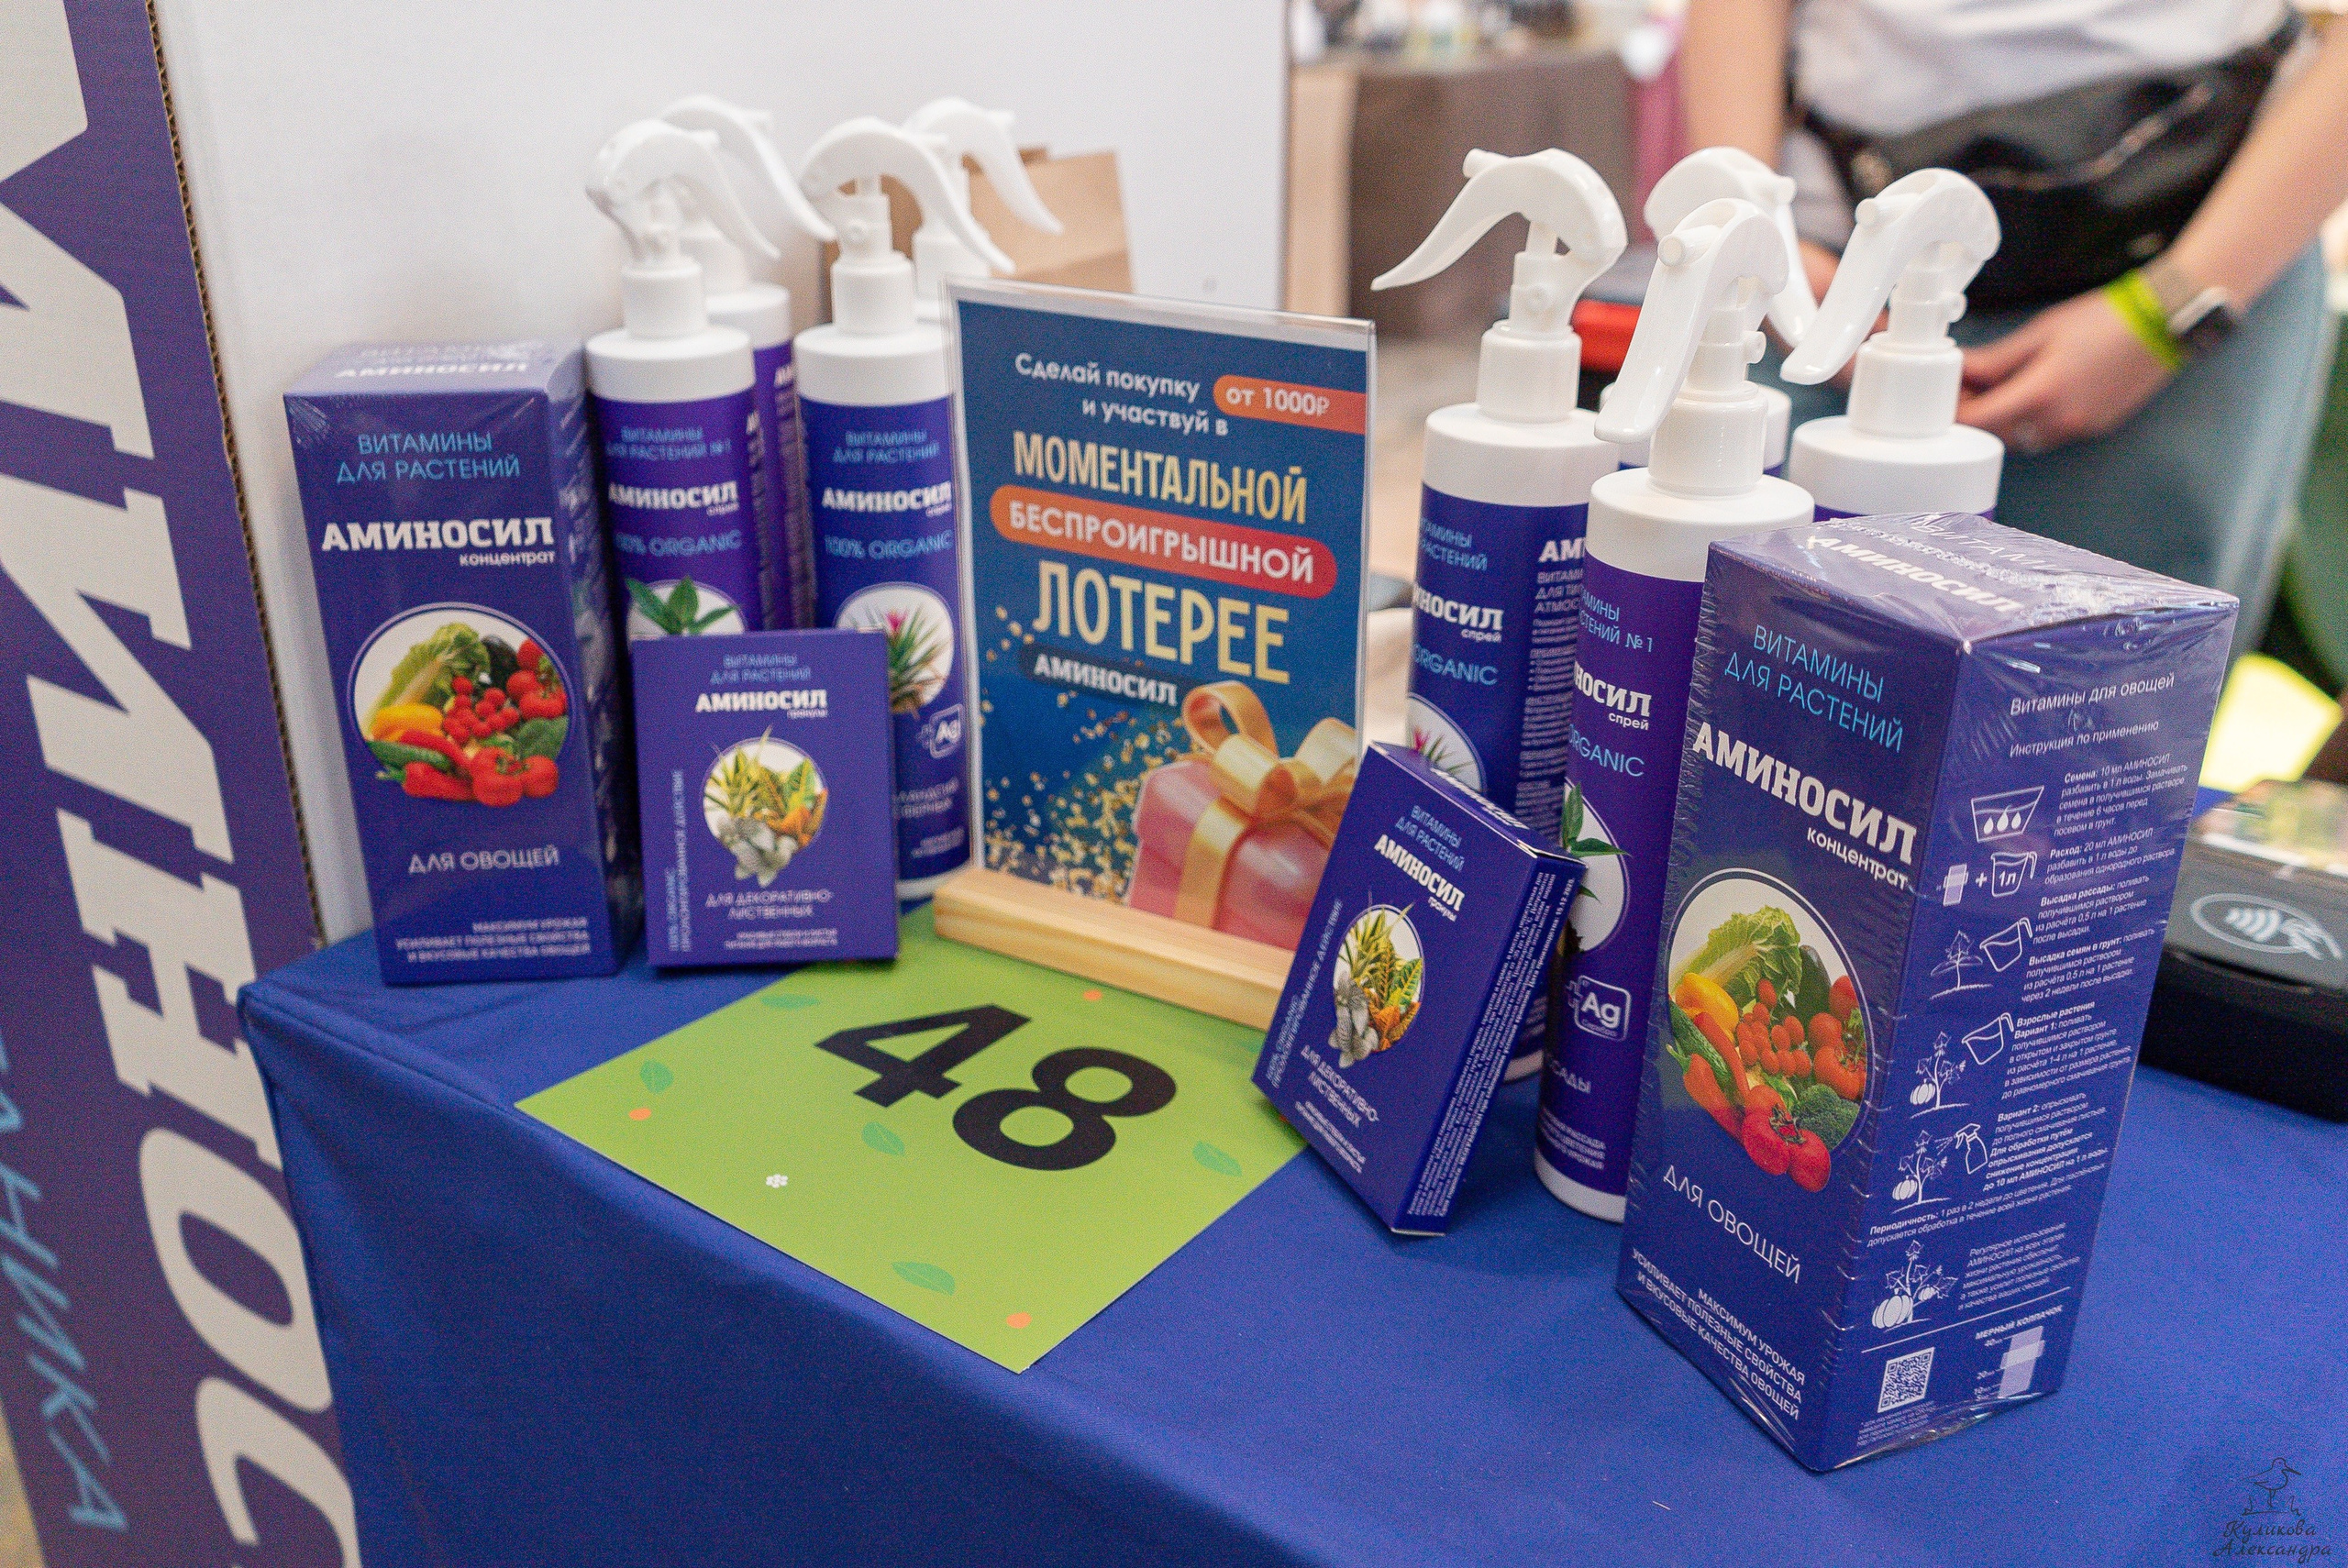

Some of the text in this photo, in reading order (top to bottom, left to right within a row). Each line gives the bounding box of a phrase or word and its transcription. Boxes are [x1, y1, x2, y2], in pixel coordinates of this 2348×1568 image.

[1014, 352, 1201, 404] Сделай покупку
[1226, 385, 1254, 406] от
[1082, 399, 1228, 437] и участвуй в
[358, 432, 493, 455] ВИТАМИНЫ
[336, 453, 520, 484] ДЛЯ РАСТЕНИЙ
[1013, 430, 1307, 525] МОМЕНТАЛЬНОЙ
[822, 480, 952, 513] АМИНОСИЛ
[321, 517, 555, 551] АМИНОСИЛ
[1010, 501, 1314, 584] БЕСПРОИГРЫШНОЙ
[460, 550, 555, 567] концентрат
[1032, 560, 1290, 684] ЛОТЕРЕЕ
[1461, 628, 1501, 644] спрей
[1625, 633, 1643, 649] №
[1034, 654, 1178, 707] АМИНОСИЛ
[1753, 624, 1884, 703] ВИТАМИНЫ
[695, 689, 827, 712] АМИНОСИЛ
[1724, 649, 1905, 754] ДЛЯ РАСТЕНИЙ
[2009, 672, 2176, 716] Витамины для овощей
[1609, 712, 1649, 731] спрей
[2008, 720, 2159, 759] Инструкция по применению
[2061, 779, 2102, 798] разбавить
[2145, 763, 2188, 779] Замачивать
[2064, 753, 2170, 783] Семена: 10 мл АМИНОСИЛ
[1691, 719, 1918, 867] АМИНОСИЛ
[2058, 797, 2088, 811] семена
[2095, 784, 2151, 803] получившимся
[2151, 777, 2185, 791] растворе
[2063, 809, 2095, 822] течение
[2102, 802, 2124, 813] часов
[2124, 798, 2148, 811] перед
[1394, 813, 1465, 873] ДЛЯ РАСТЕНИЙ
[1410, 803, 1463, 849] ВИТАМИНЫ
[2049, 843, 2082, 859] Расход:
[2083, 841, 2094, 851] 20
[2107, 827, 2153, 846] АМИНОСИЛ
[2053, 823, 2087, 836] посевом
[408, 844, 559, 875] ДЛЯ ОВОЩЕЙ
[1374, 834, 1466, 911] АМИНОСИЛ
[1806, 826, 1908, 896] концентрат
[2043, 847, 2176, 886] образования однородного раствора
[2045, 855, 2087, 873] разбавить
[2107, 848, 2127, 859] воды
[2127, 845, 2138, 855] до
[2037, 890, 2134, 921] получившимся раствором
[2040, 874, 2150, 907] Высадка рассады: поливать
[2028, 949, 2066, 966] Высадка
[2066, 944, 2090, 956] семян
[2098, 937, 2121, 950] грунт:
[2032, 933, 2055, 944] после
[1580, 991, 1621, 1029] Ag
[2016, 1001, 2095, 1029] Взрослые растения
[2013, 1022, 2048, 1041] Вариант
[814, 1003, 1177, 1171] 48
[1301, 1042, 1380, 1127] ДЛЯ ДЕКОРАТИВНО-
[1307, 1068, 1361, 1130] ЛИСТВЕННЫХ
[1663, 1160, 1801, 1288] ДЛЯ ОВОЩЕЙ
[1869, 1209, 1939, 1237] Периодичность:
[1632, 1247, 1802, 1406] УСИЛИВАЕТ ПОЛЕЗНЫЕ СВОЙСТВА
[1698, 1286, 1805, 1388] МАКСИМУМ УРОЖАЯ
[1975, 1320, 2015, 1340] МЕРНЫЙ
[1637, 1270, 1645, 1285] И
[1645, 1277, 1697, 1331] ВКУСОВЫЕ
[1697, 1323, 1749, 1378] КАЧЕСТВА
[1750, 1368, 1800, 1424] ОВОЩЕЙ
